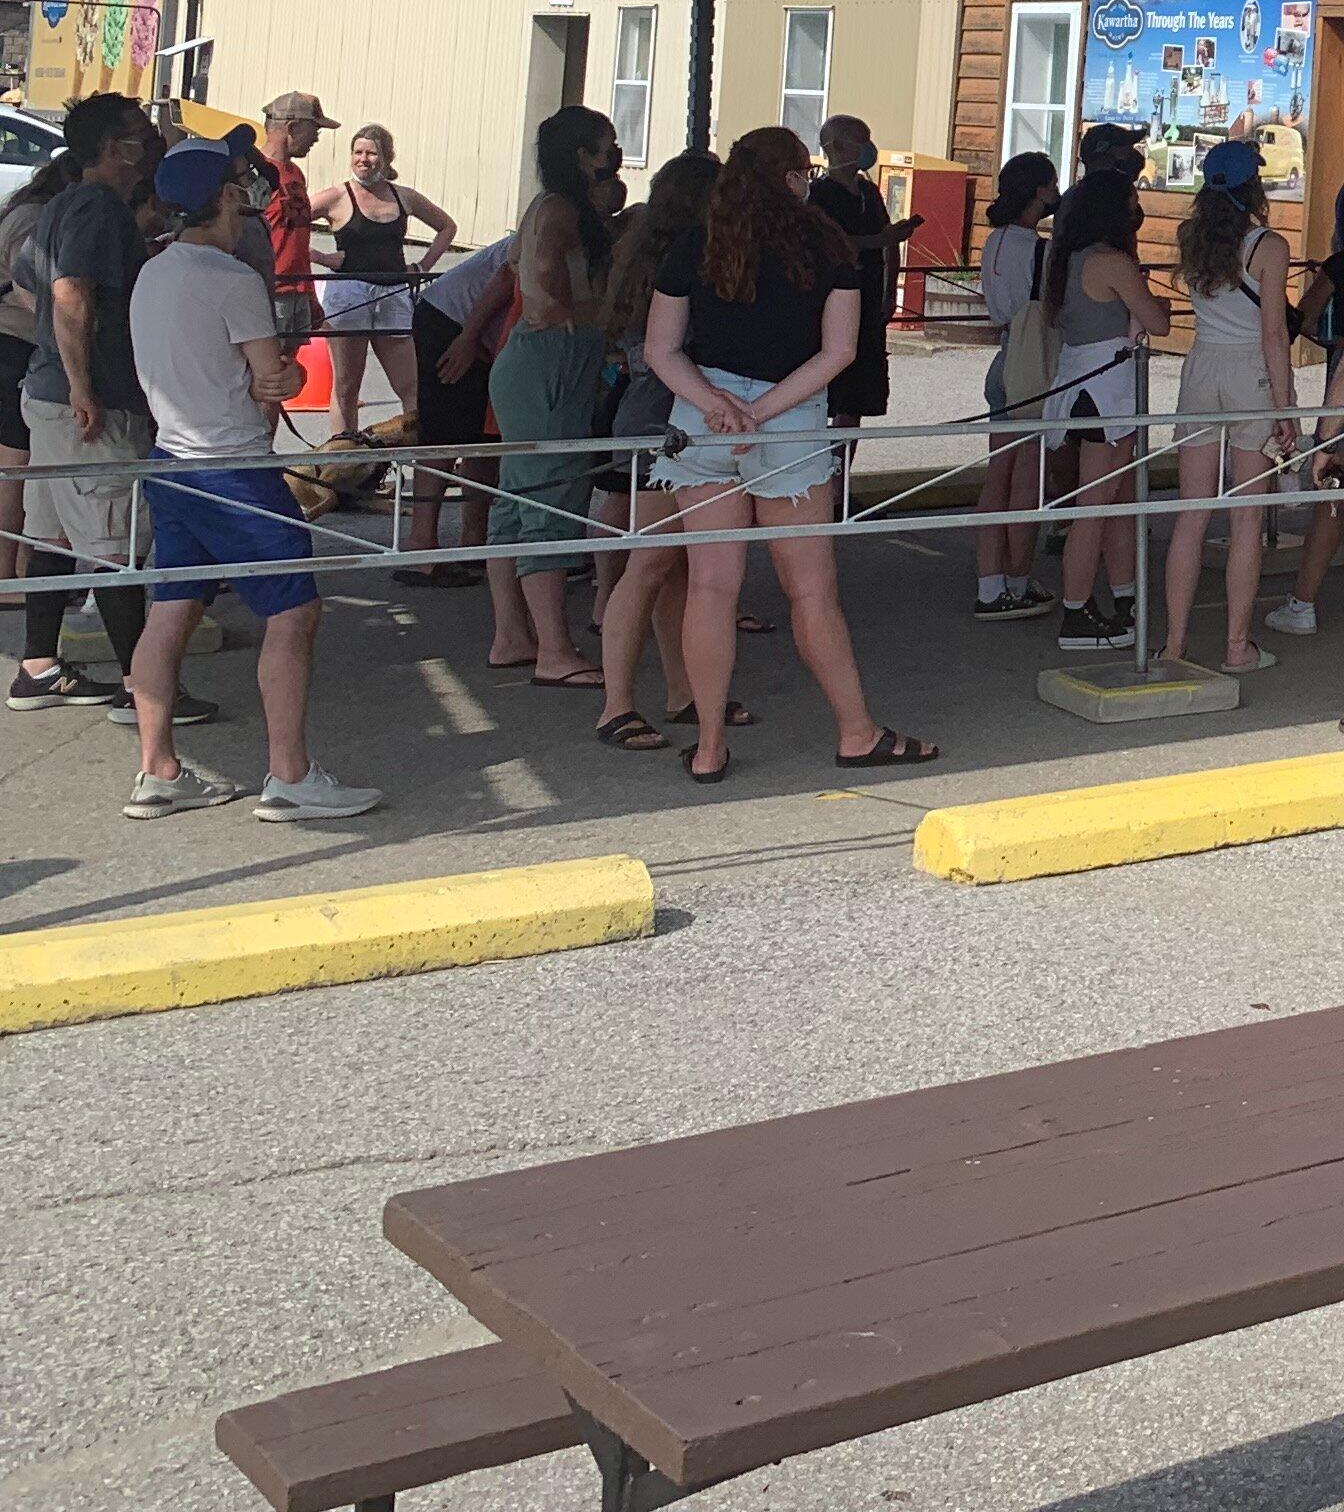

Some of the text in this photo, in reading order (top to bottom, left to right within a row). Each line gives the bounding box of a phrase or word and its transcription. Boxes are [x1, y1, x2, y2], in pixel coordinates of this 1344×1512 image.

[1097, 14, 1139, 31] Kawartha
[1146, 11, 1235, 32] Through The Years
